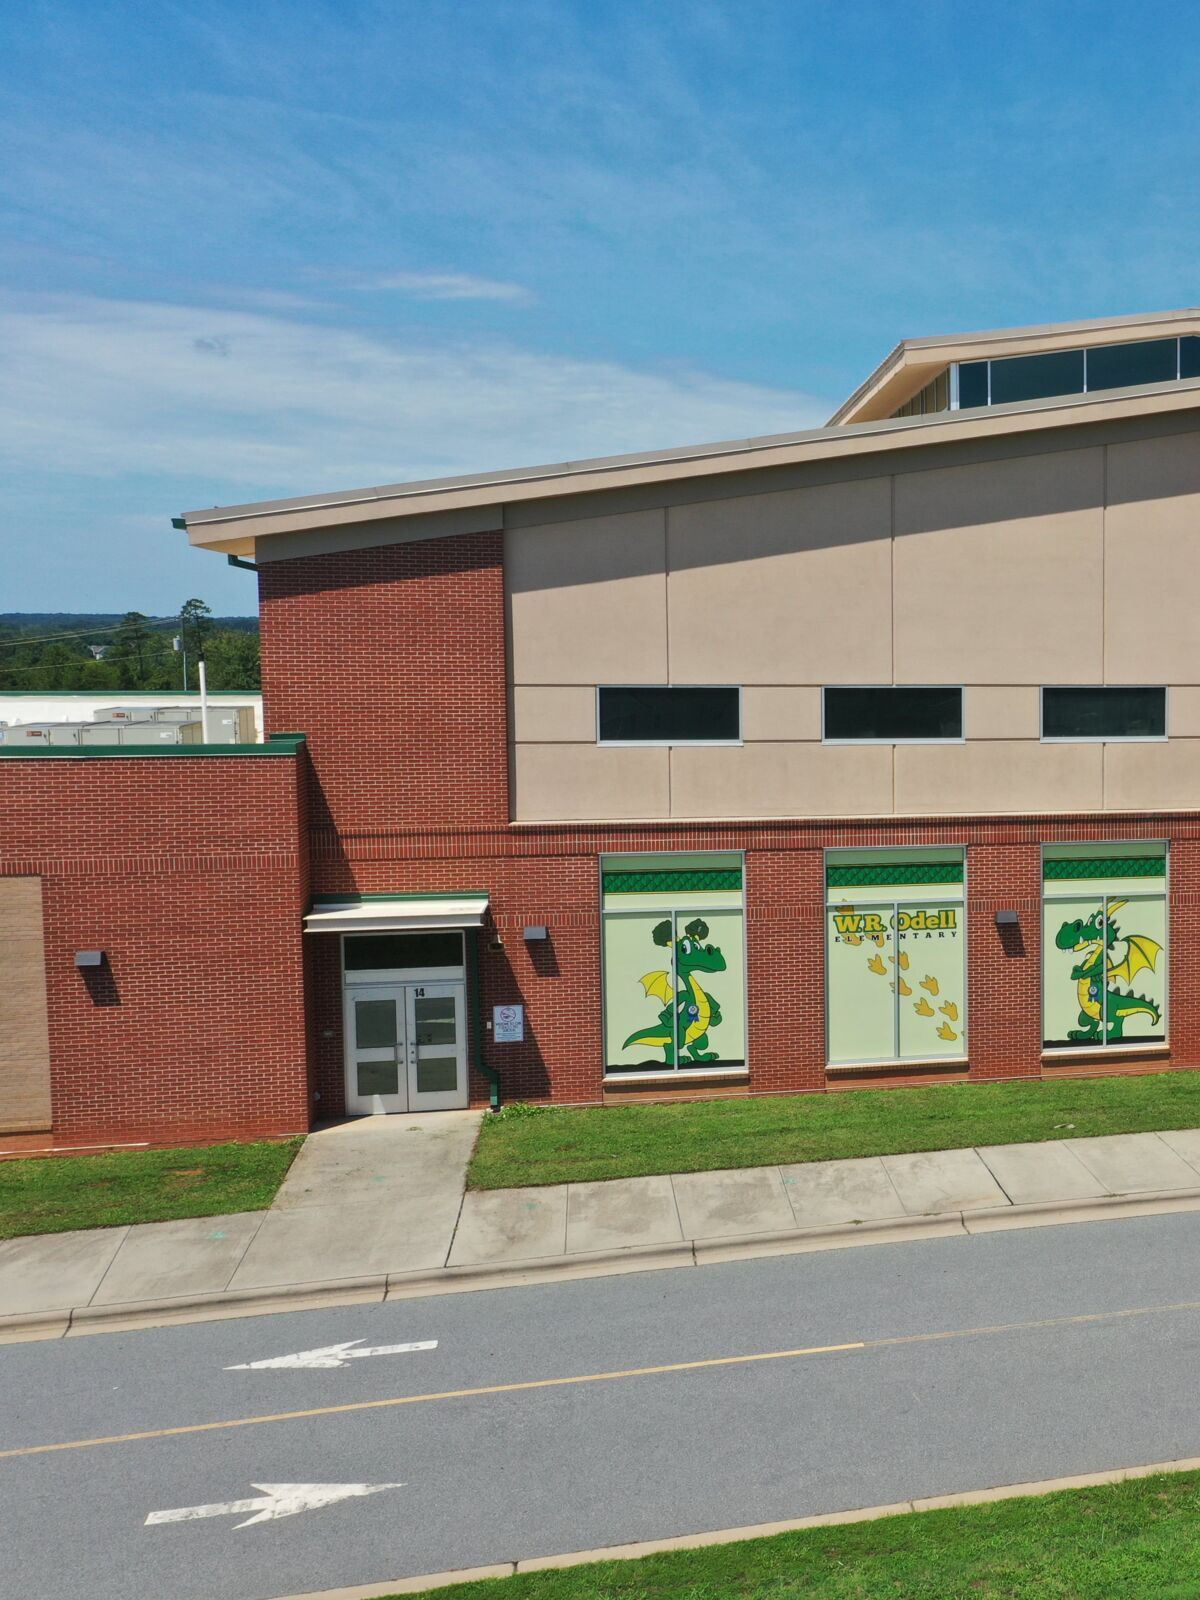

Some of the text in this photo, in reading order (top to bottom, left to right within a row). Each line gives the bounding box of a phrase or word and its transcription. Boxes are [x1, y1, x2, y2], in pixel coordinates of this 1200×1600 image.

[890, 909, 957, 931] Odell
[835, 931, 957, 943] ELEMENTARY
[414, 987, 425, 998] 14
